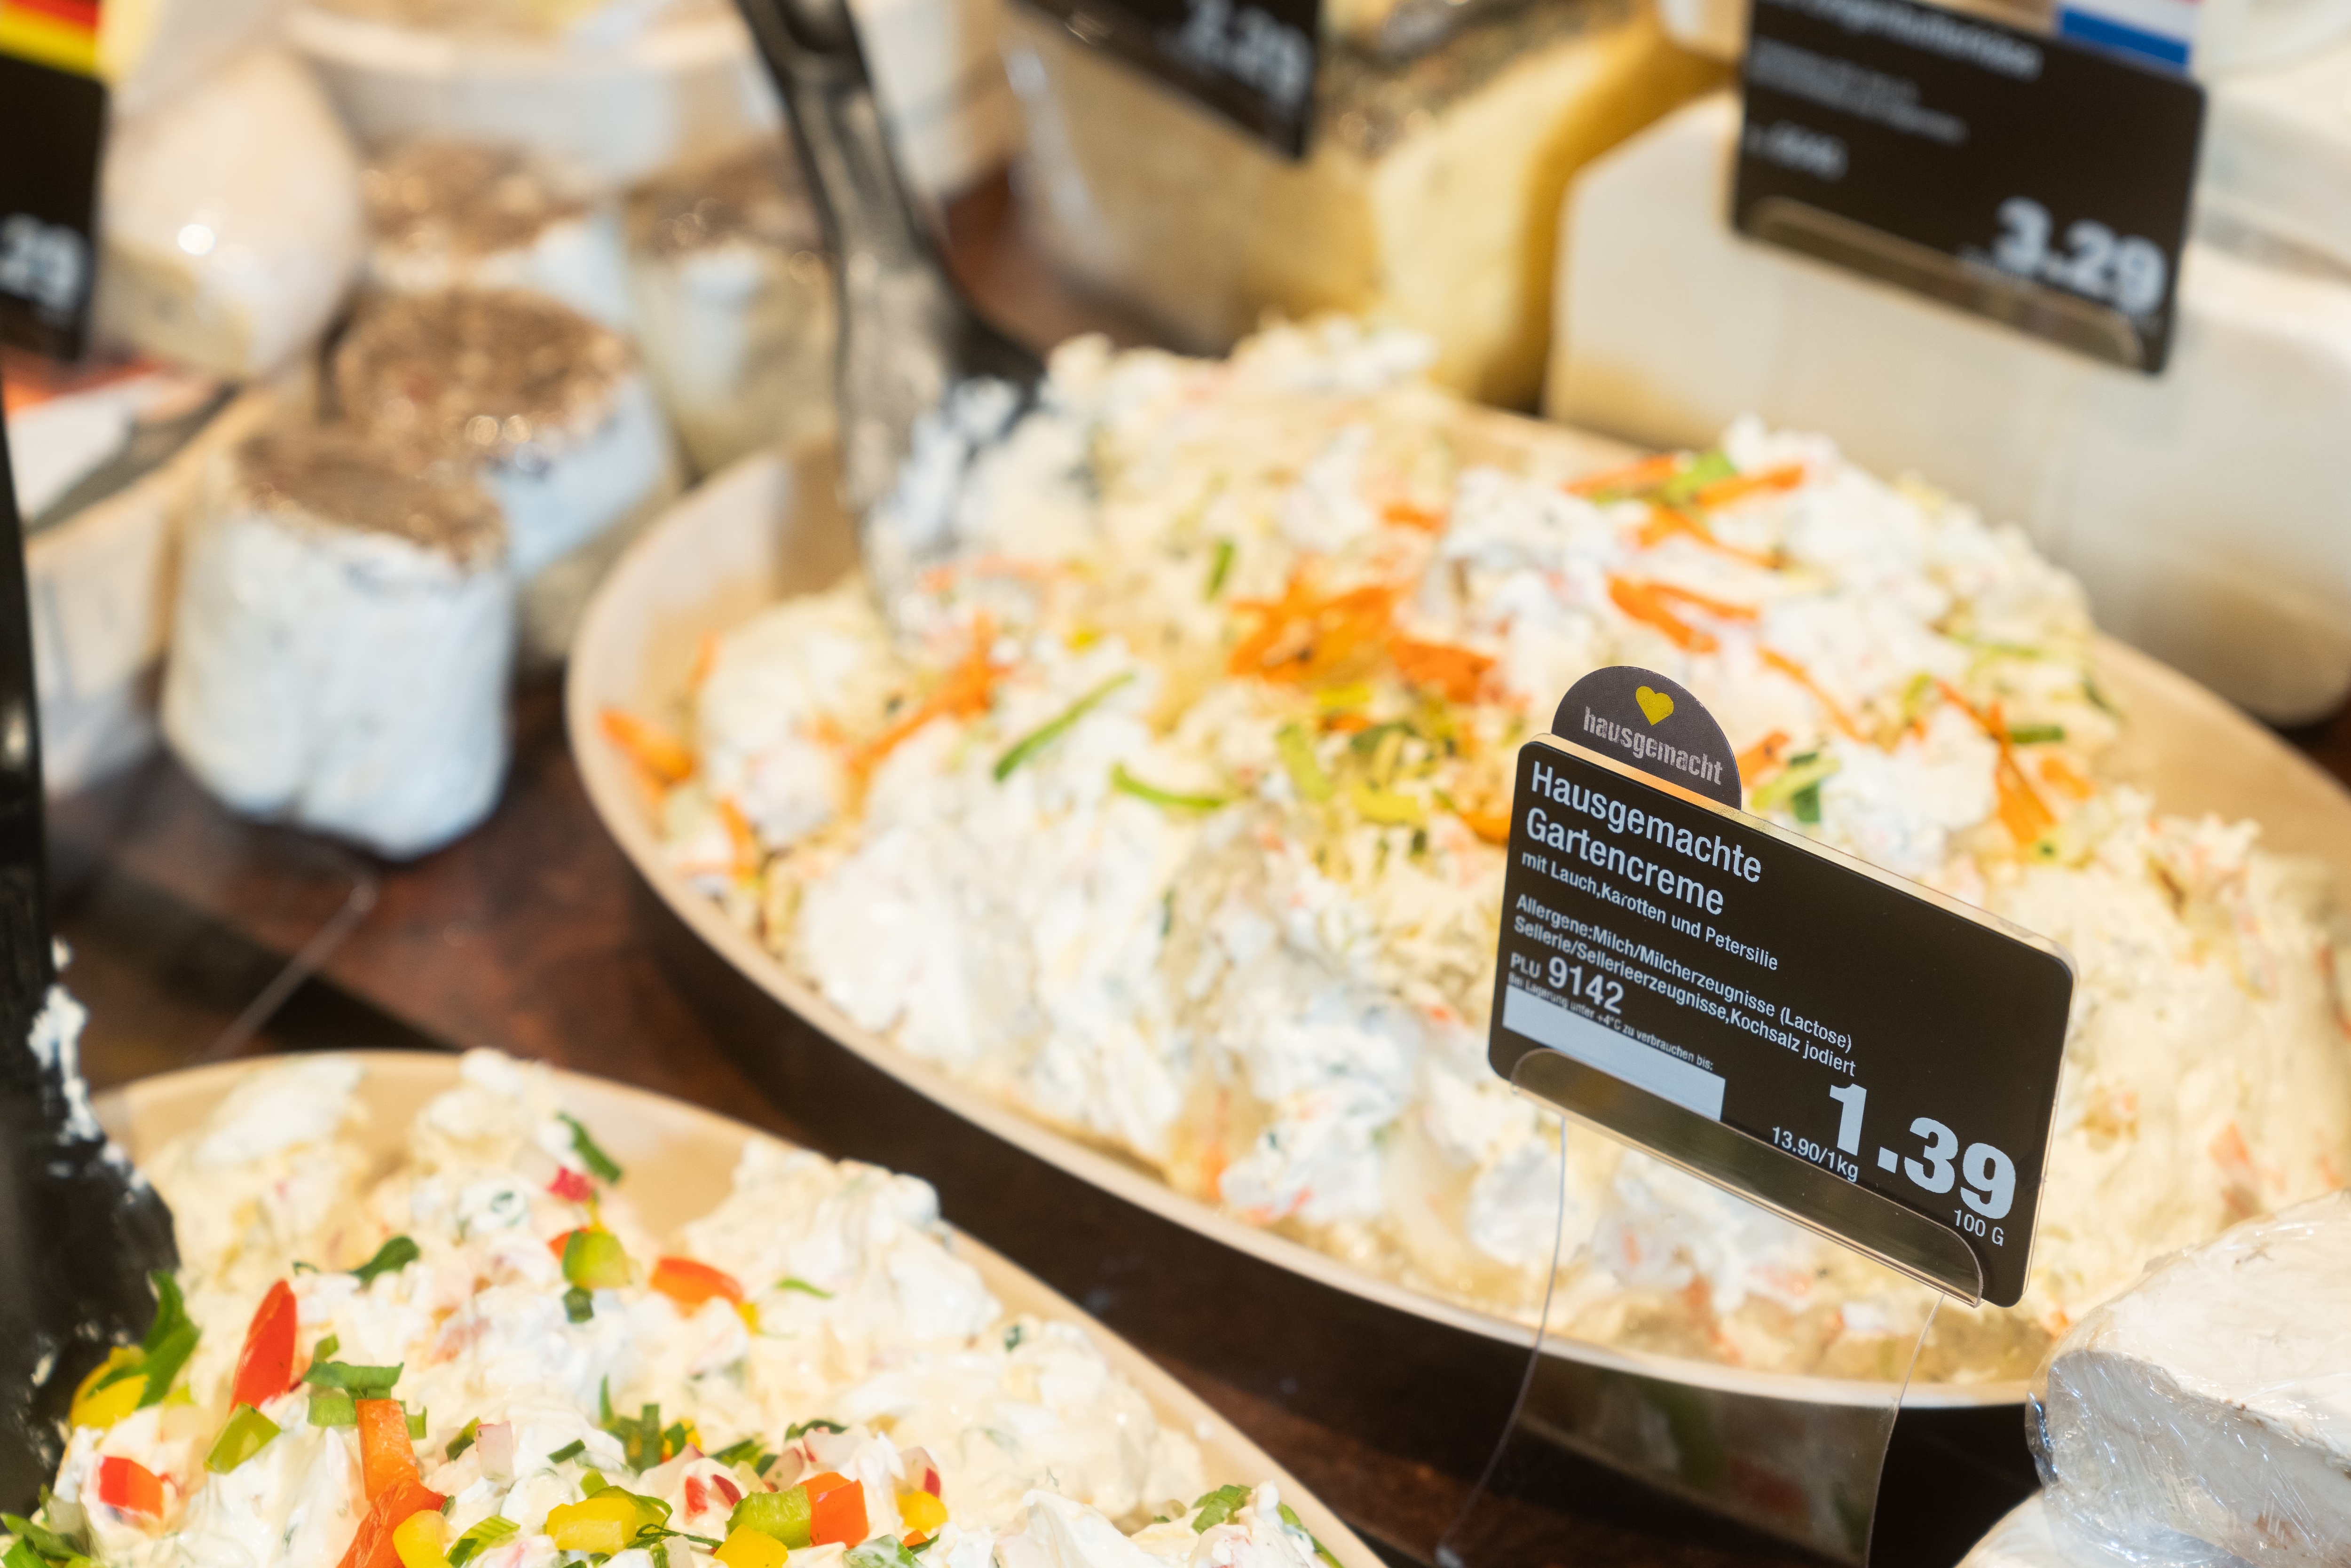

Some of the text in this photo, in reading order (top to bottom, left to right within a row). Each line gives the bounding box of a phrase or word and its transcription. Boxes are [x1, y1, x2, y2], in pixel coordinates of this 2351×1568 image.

[1994, 197, 2166, 314] 3.29
[1583, 706, 1722, 785] hausgemacht
[1526, 807, 1724, 915] Gartencreme
[1531, 761, 1761, 882] Hausgemachte
[1522, 851, 1778, 971] mit Lauch,Karotten und Petersilie
[1510, 952, 1625, 1015] PLU 9142
[1514, 915, 1856, 1077] Sellerie/Sellerieerzeugnisse,Kochsalz jodiert
[1515, 894, 1852, 1054] Allergene:Milch/Milcherzeugnisse (Lactose)
[1525, 979, 1570, 1009] Lagerung
[1570, 998, 1595, 1020] unter
[1622, 1024, 1634, 1037] zu
[1636, 1029, 1695, 1063] verbrauchen
[1696, 1054, 1714, 1071] bis:
[1772, 1127, 1859, 1183] 13.90/1kg
[1829, 1083, 2016, 1220] 1.39
[1954, 1209, 2004, 1246] 100 G
